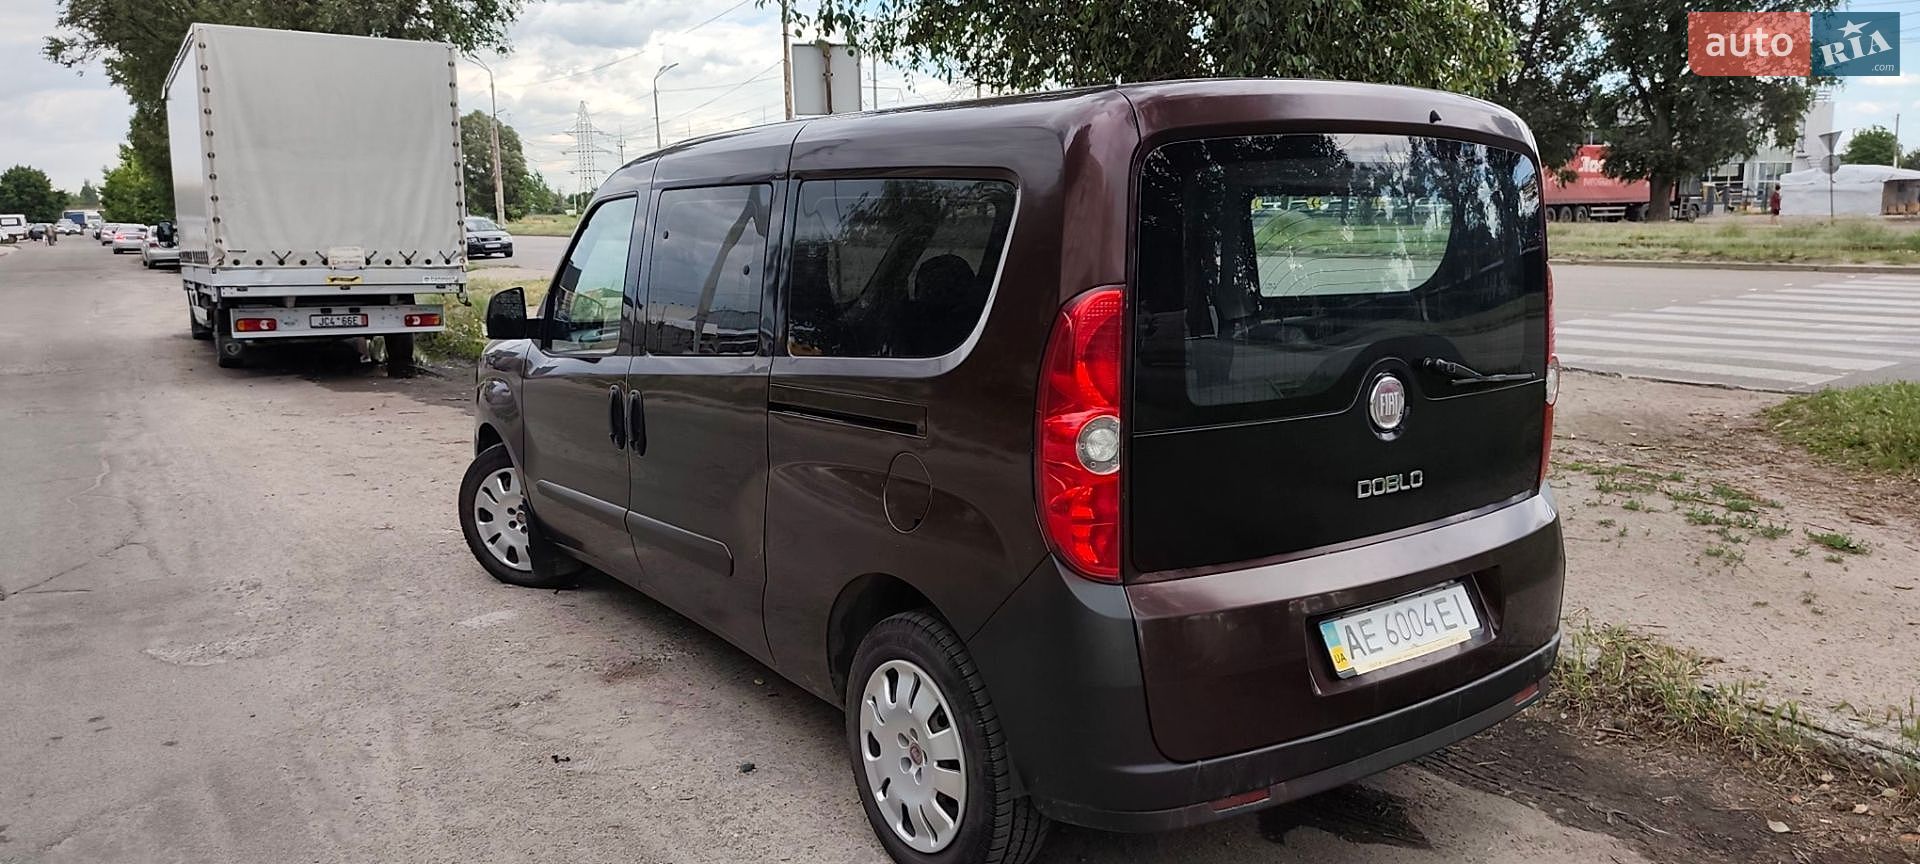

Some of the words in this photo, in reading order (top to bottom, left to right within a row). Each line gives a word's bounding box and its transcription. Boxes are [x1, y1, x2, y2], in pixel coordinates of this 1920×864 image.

[1380, 392, 1399, 416] FIAT
[1357, 469, 1423, 499] DOBLO
[1344, 618, 1383, 660] AE
[1384, 603, 1438, 645] 6004
[1434, 594, 1468, 631] EI
[1334, 652, 1347, 664] UA
